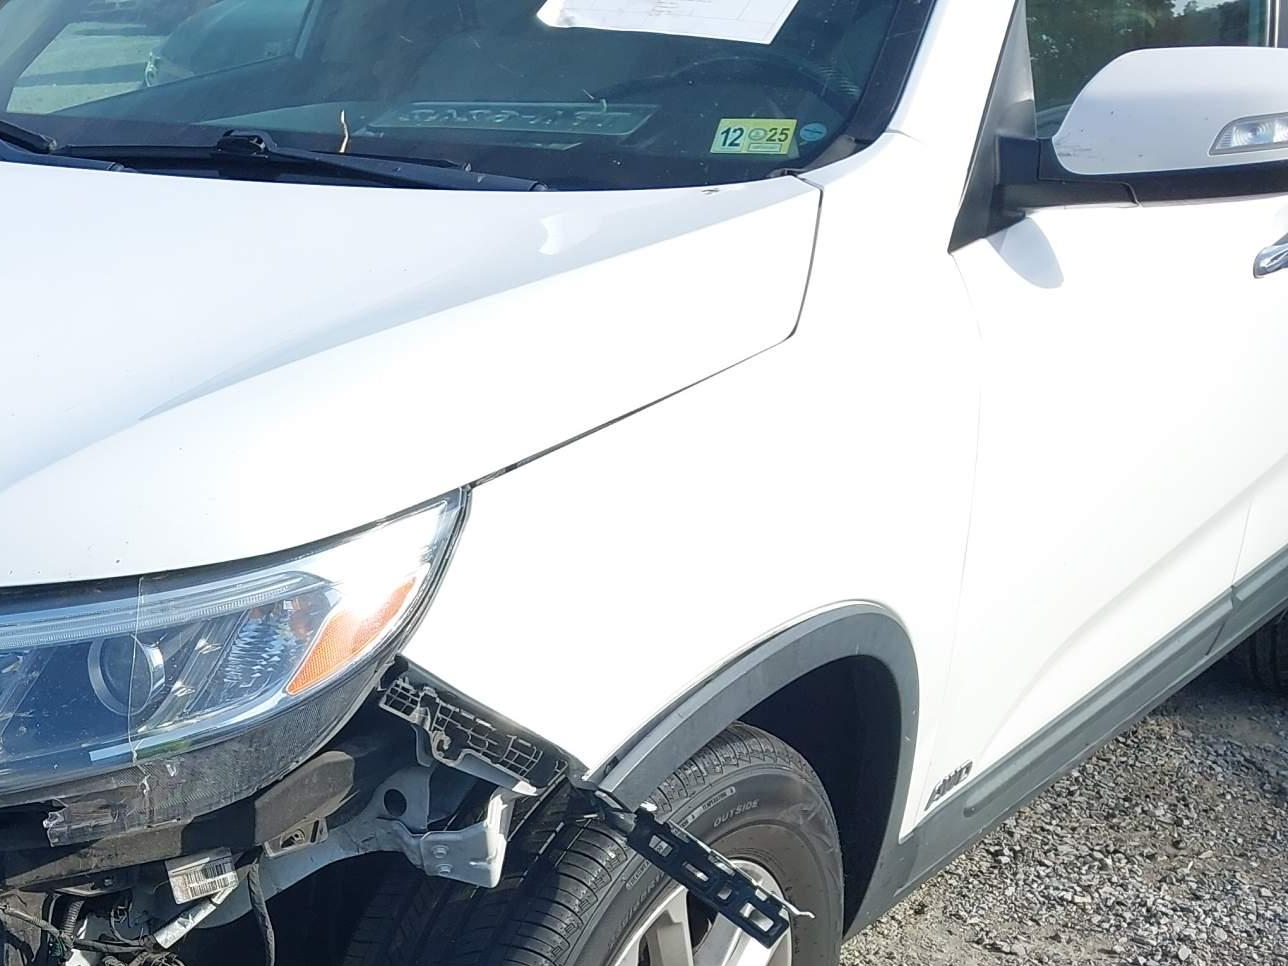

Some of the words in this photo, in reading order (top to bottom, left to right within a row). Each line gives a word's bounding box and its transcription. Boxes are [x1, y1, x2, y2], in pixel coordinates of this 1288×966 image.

[720, 127, 745, 148] 12
[765, 127, 791, 143] 25
[713, 799, 759, 828] OUTSIDE
